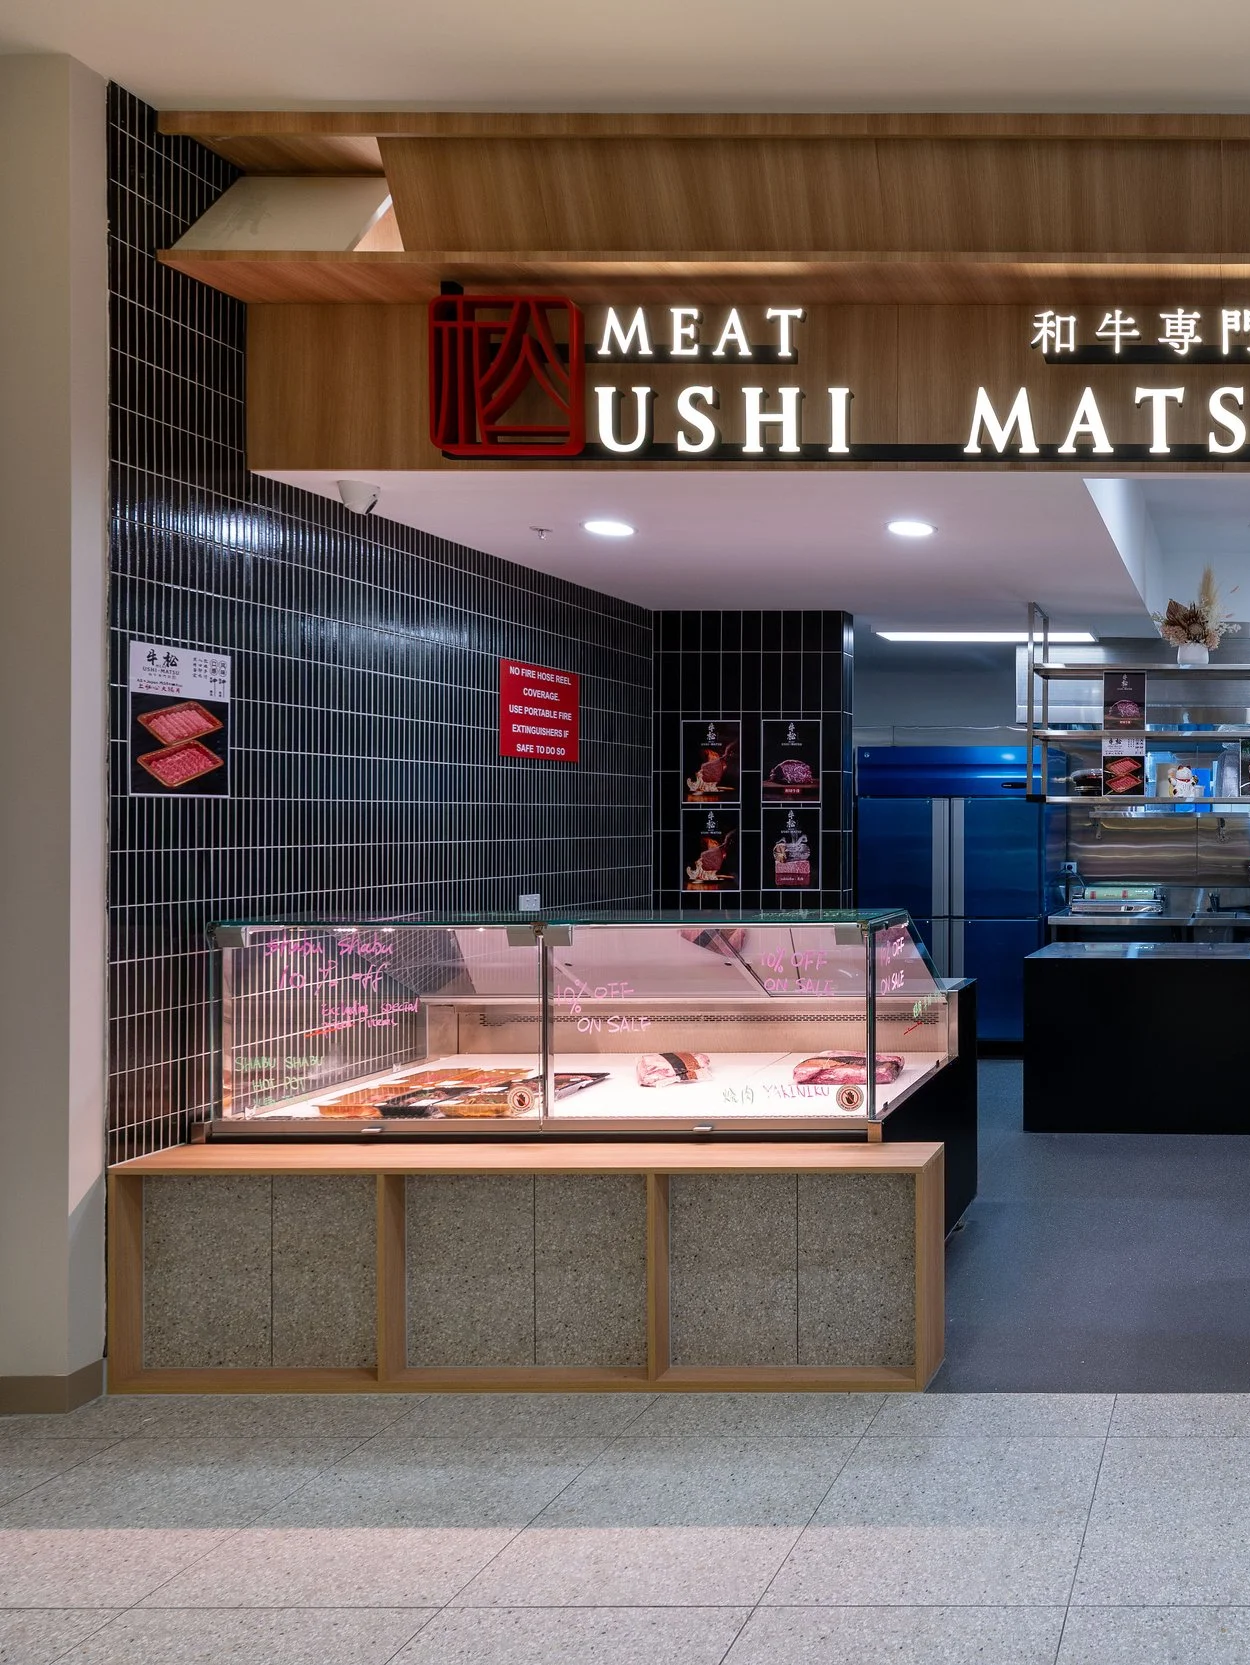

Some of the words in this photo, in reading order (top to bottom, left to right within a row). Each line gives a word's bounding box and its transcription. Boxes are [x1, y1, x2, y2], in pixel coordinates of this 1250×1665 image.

[597, 307, 803, 357] MEAT
[594, 386, 851, 453] USHI
[509, 666, 520, 676] NO
[521, 669, 536, 679] FIRE
[537, 673, 555, 682] HOSE
[555, 676, 572, 686] REEL
[509, 704, 523, 714] USE
[524, 706, 558, 719] PORTABLE
[558, 713, 572, 721] FIRE
[512, 724, 563, 738] EXTINGUISHERS
[563, 730, 569, 738] IF
[516, 744, 534, 753] SAFE
[536, 745, 545, 754] TO
[545, 747, 555, 755] DO
[556, 748, 566, 756] SO
[764, 978, 788, 991] ON
[577, 1017, 602, 1035] ON
[235, 1056, 277, 1072] SHABU
[285, 1055, 325, 1069] SHABU
